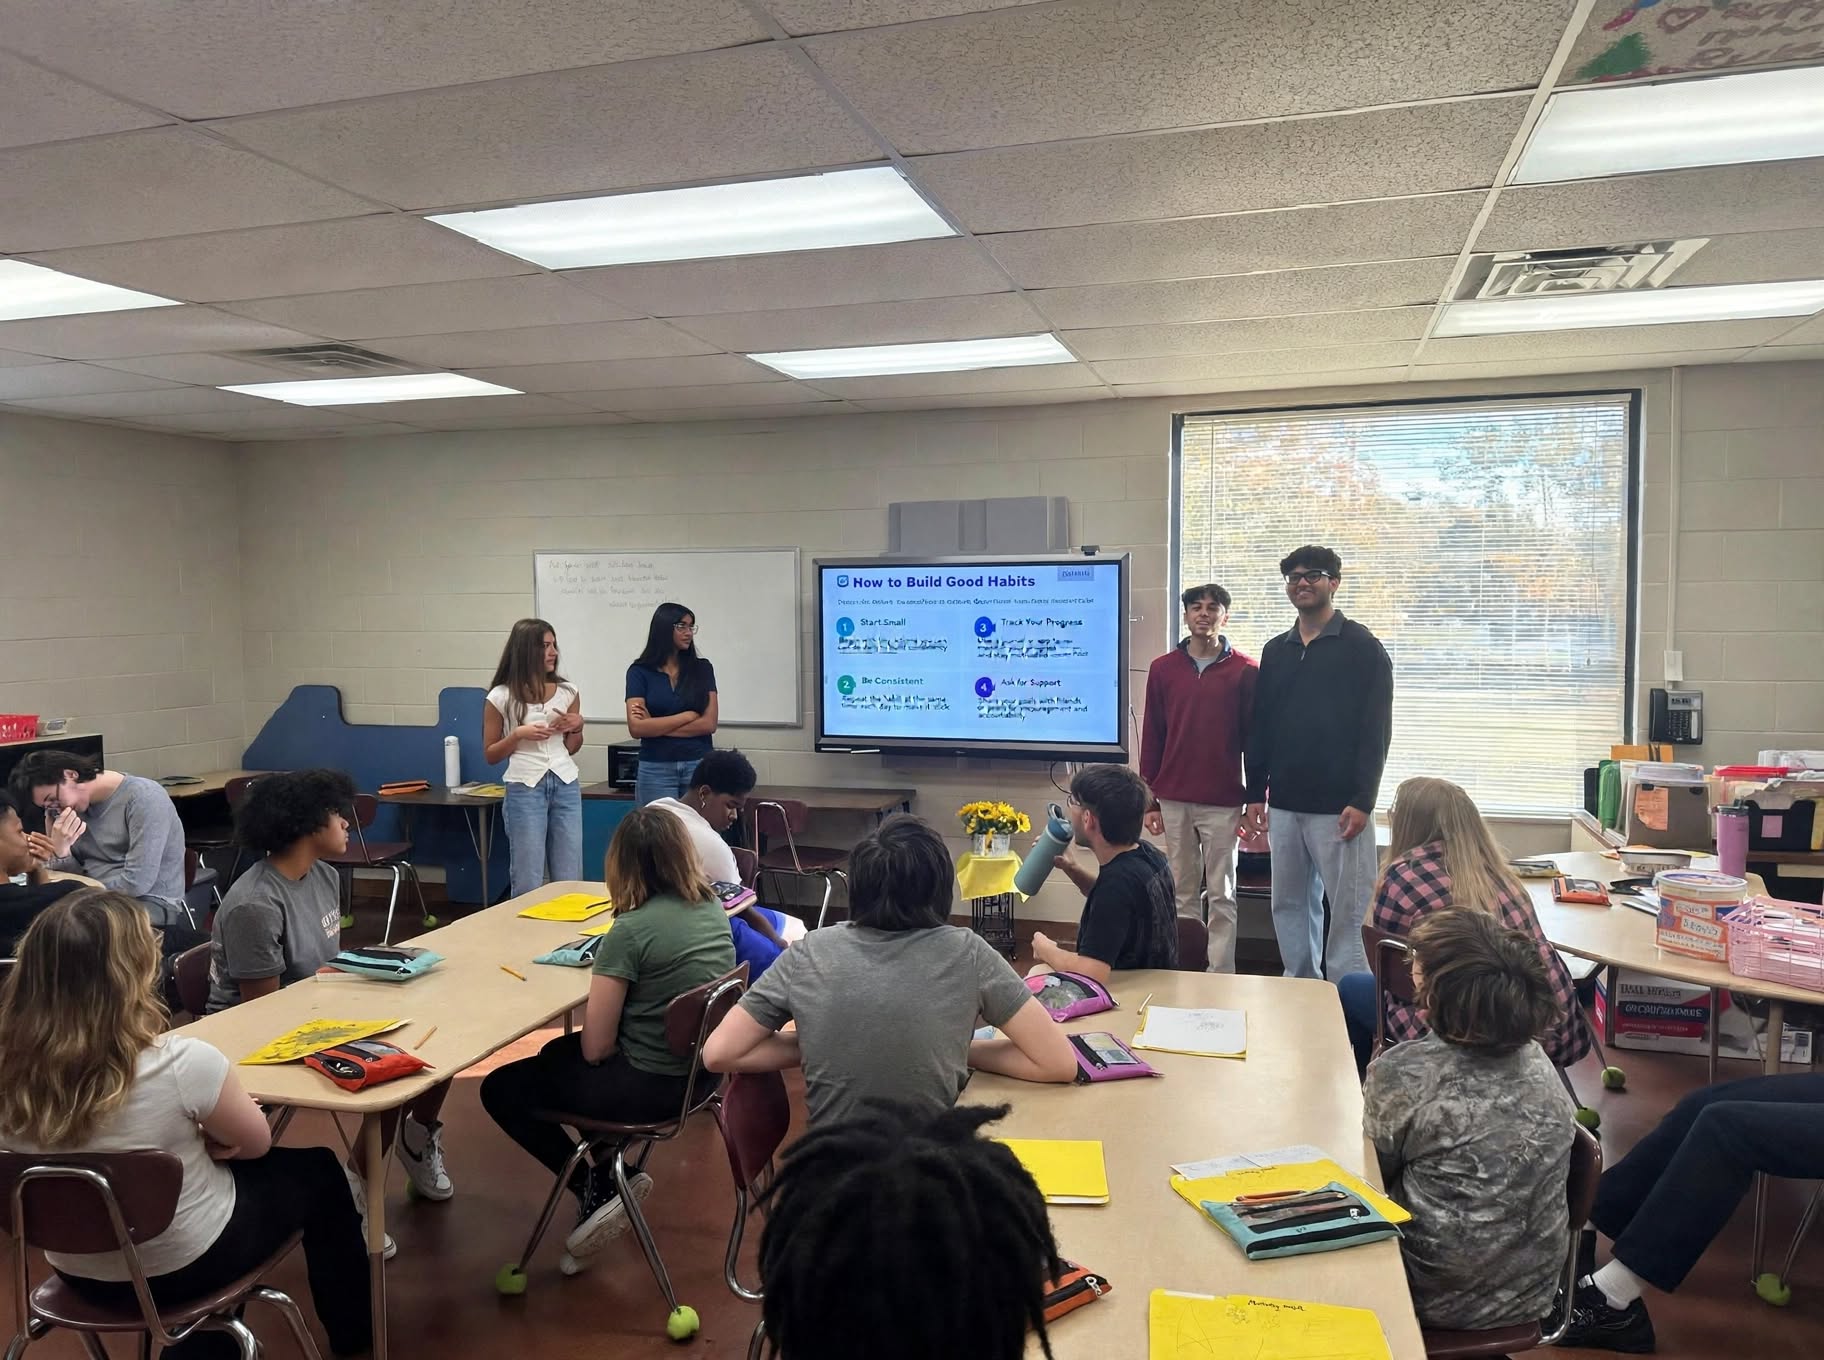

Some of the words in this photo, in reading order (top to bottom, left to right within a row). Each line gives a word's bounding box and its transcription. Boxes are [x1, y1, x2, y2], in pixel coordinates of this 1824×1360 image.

[853, 577, 883, 588] How
[888, 577, 902, 588] to
[907, 576, 941, 588] Build
[946, 576, 983, 587] Good
[988, 575, 1036, 587] Habits
[860, 618, 881, 626] Start
[883, 618, 906, 626] Small
[1001, 618, 1023, 627] Track
[1025, 618, 1043, 626] Your
[1046, 618, 1083, 628] Progress
[875, 677, 924, 685] Consistent
[1001, 677, 1015, 686] Ask
[1030, 678, 1062, 687] Support
